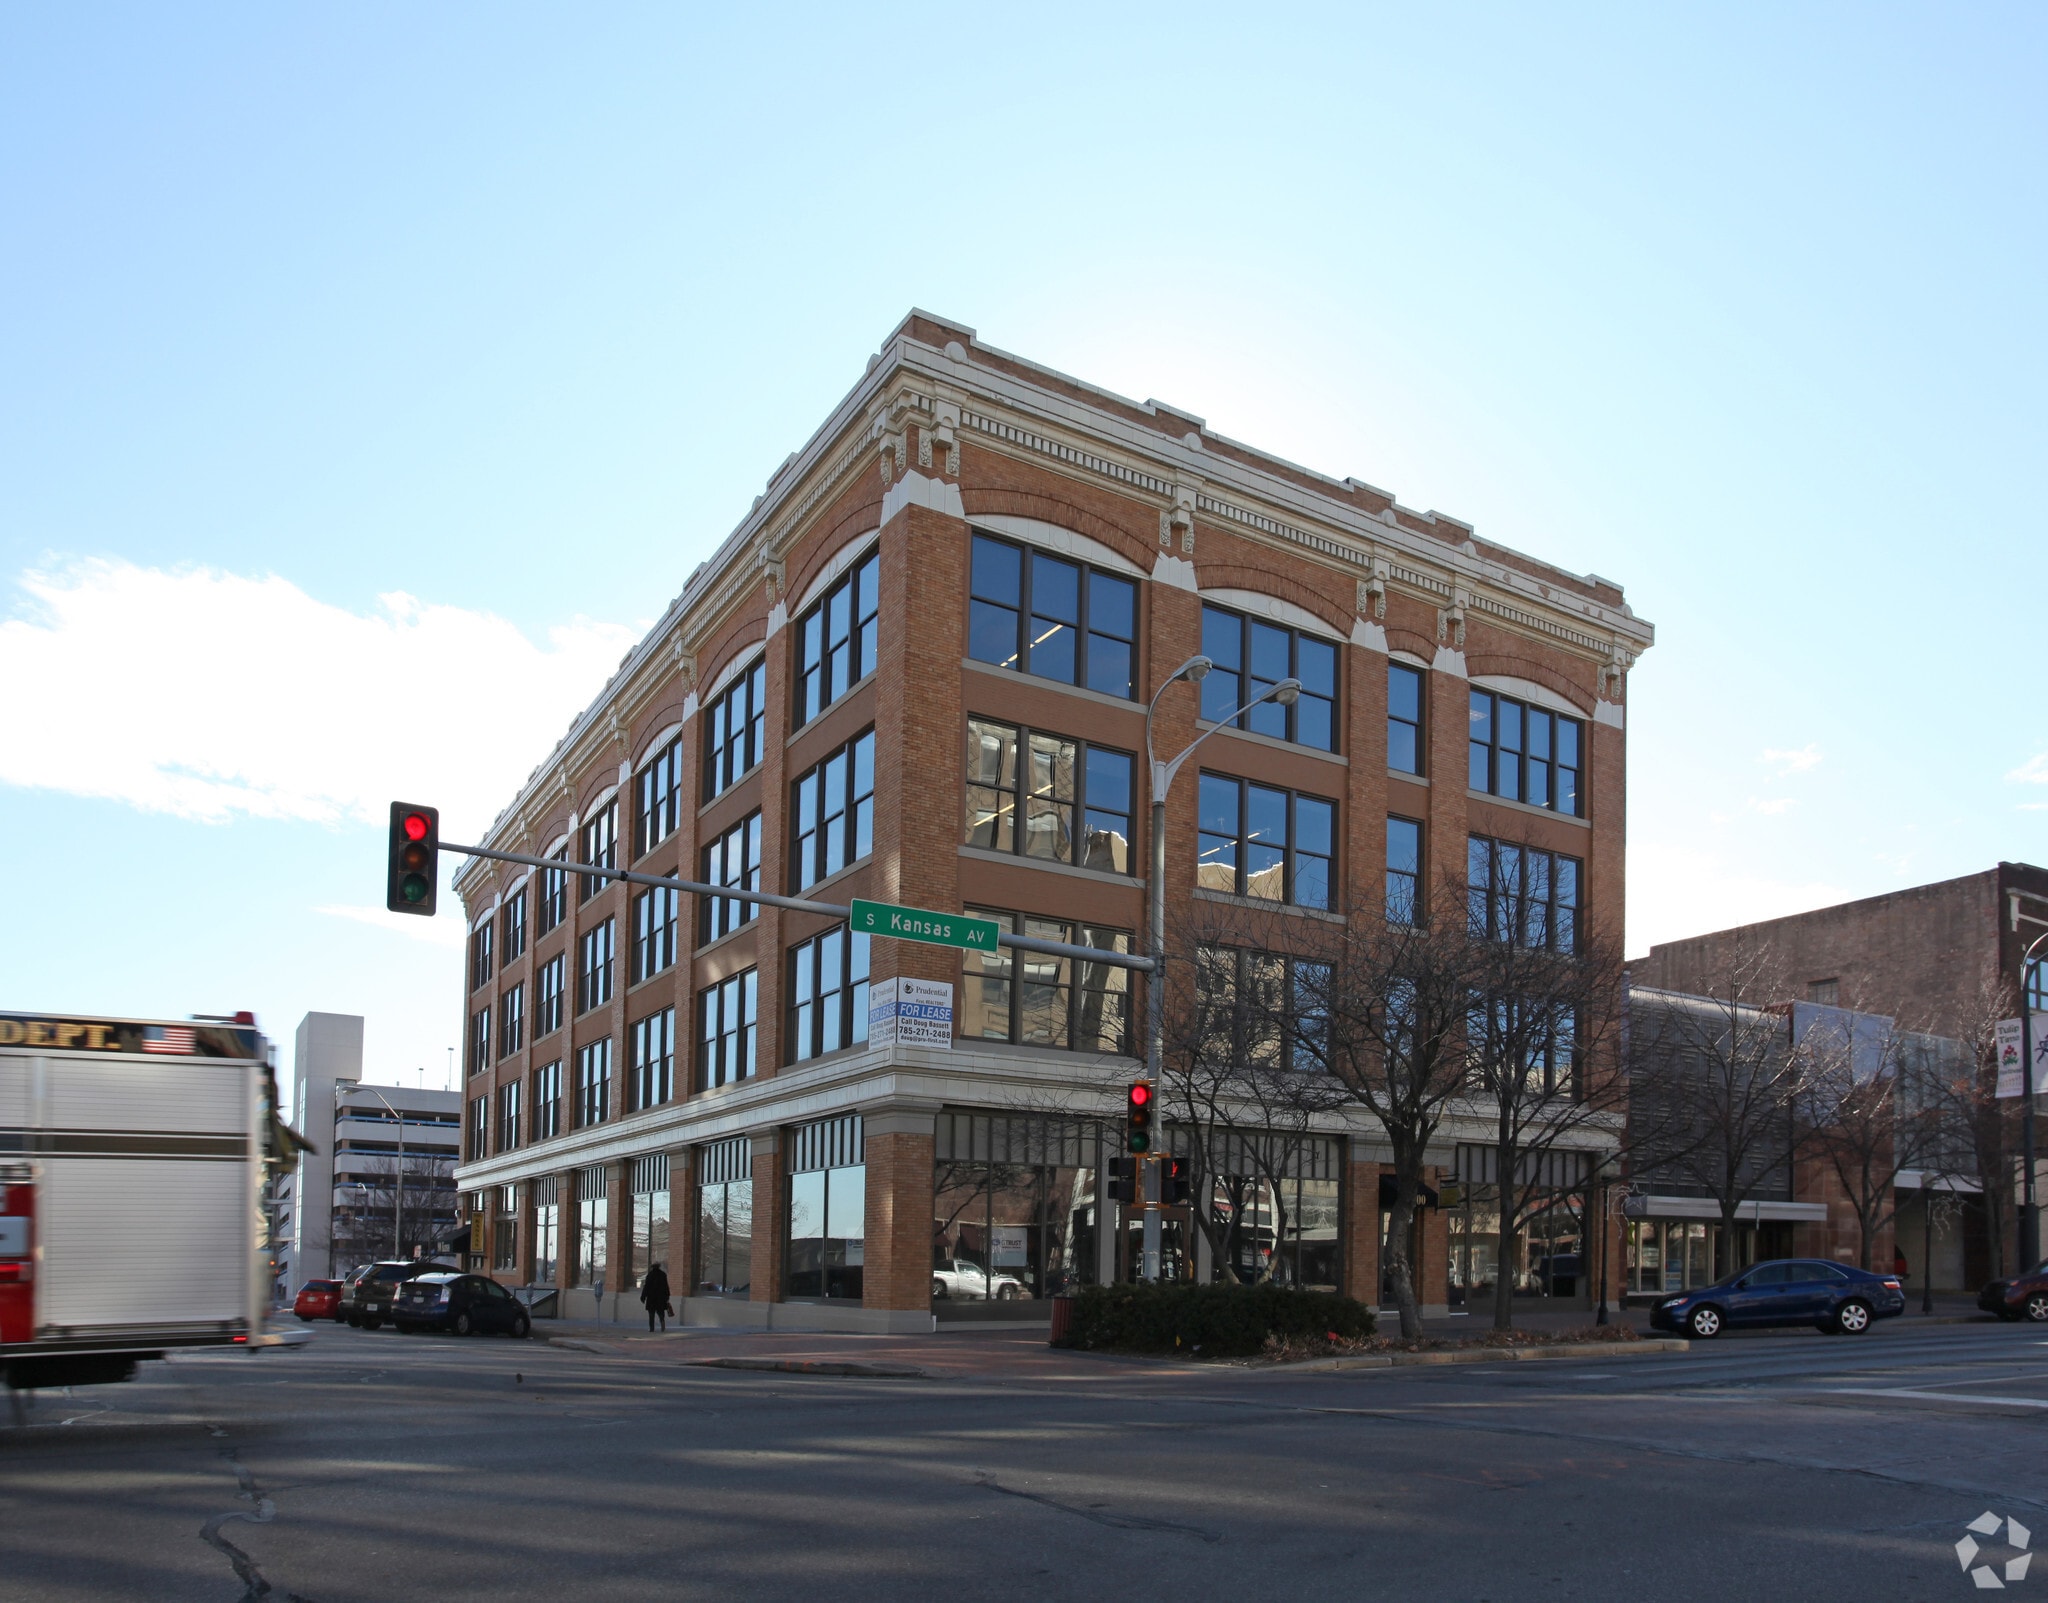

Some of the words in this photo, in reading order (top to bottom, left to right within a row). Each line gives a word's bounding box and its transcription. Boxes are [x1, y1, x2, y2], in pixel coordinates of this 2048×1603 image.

[866, 912, 875, 926] S
[890, 913, 951, 937] Kansas
[966, 930, 985, 943] AV
[915, 986, 948, 997] Prudential
[879, 1003, 896, 1020] LEASE
[900, 1004, 920, 1016] FOR
[921, 1006, 952, 1020] LEASE
[913, 1019, 928, 1028] Doug
[928, 1021, 949, 1029] Bassett
[1997, 1024, 2020, 1035] Tulip
[0, 1020, 122, 1049] DEPT.
[899, 1026, 951, 1039] 785-271-2488
[1998, 1035, 2020, 1044] Time
